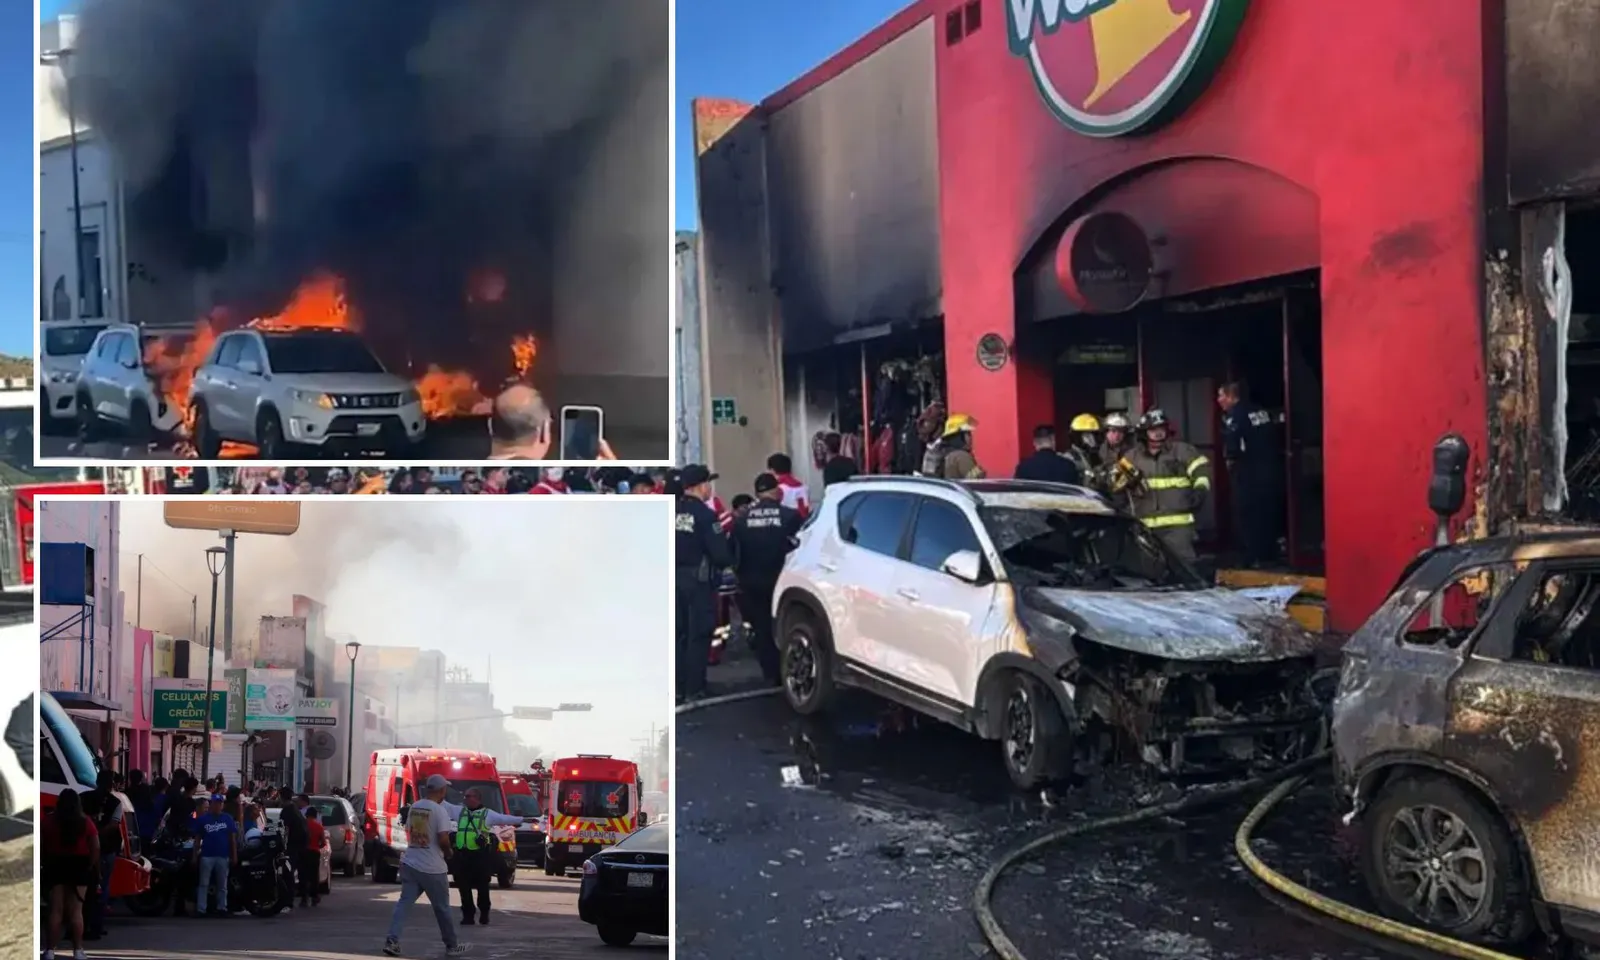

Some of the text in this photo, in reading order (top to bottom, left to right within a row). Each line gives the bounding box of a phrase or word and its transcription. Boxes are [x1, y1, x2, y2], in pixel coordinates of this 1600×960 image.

[161, 692, 220, 701] CELULARS
[186, 701, 194, 709] A
[298, 700, 333, 709] PAYJOY
[168, 708, 206, 718] CREDIT
[204, 821, 227, 832] Dodgers
[568, 830, 616, 841] AMBULANCIA
